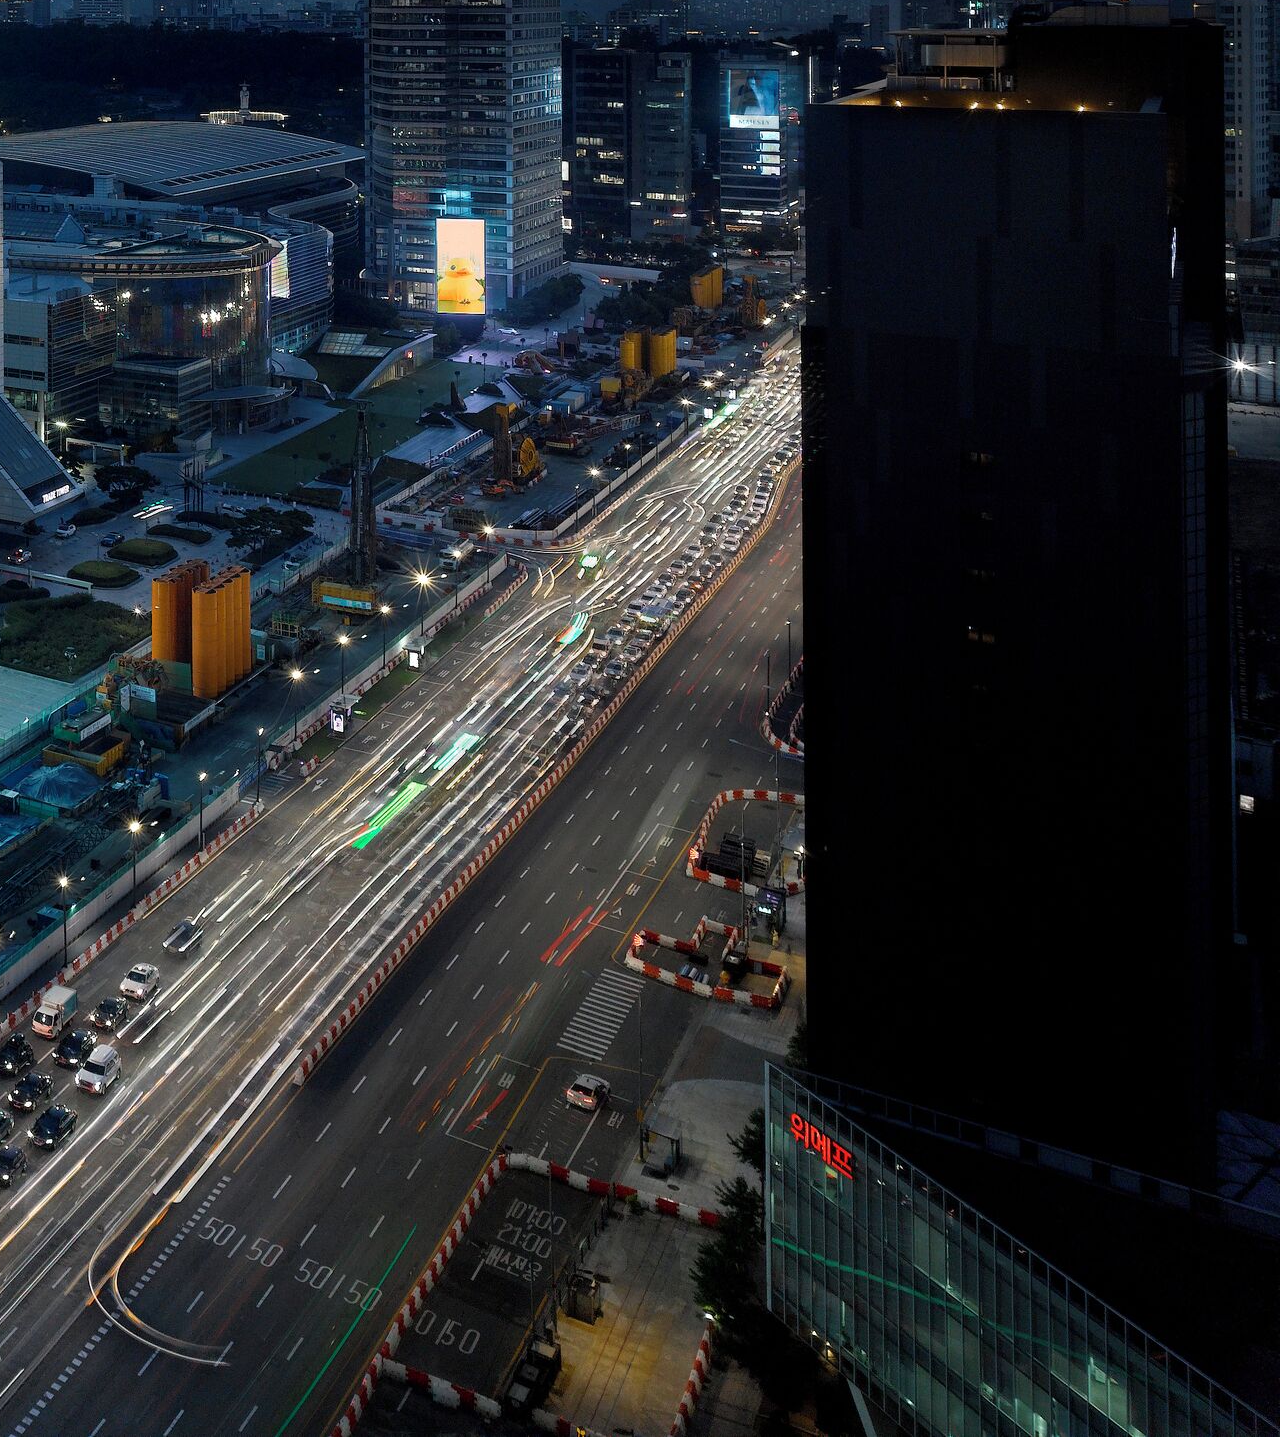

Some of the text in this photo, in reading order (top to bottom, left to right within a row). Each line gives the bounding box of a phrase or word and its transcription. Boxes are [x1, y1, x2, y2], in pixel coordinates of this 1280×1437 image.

[42, 484, 70, 504] TRADE TOWER
[789, 1112, 855, 1181] 위메프
[497, 1222, 552, 1260] 21:00
[198, 1215, 383, 1313] 50 50 50 50
[485, 1243, 543, 1284] 버스전용
